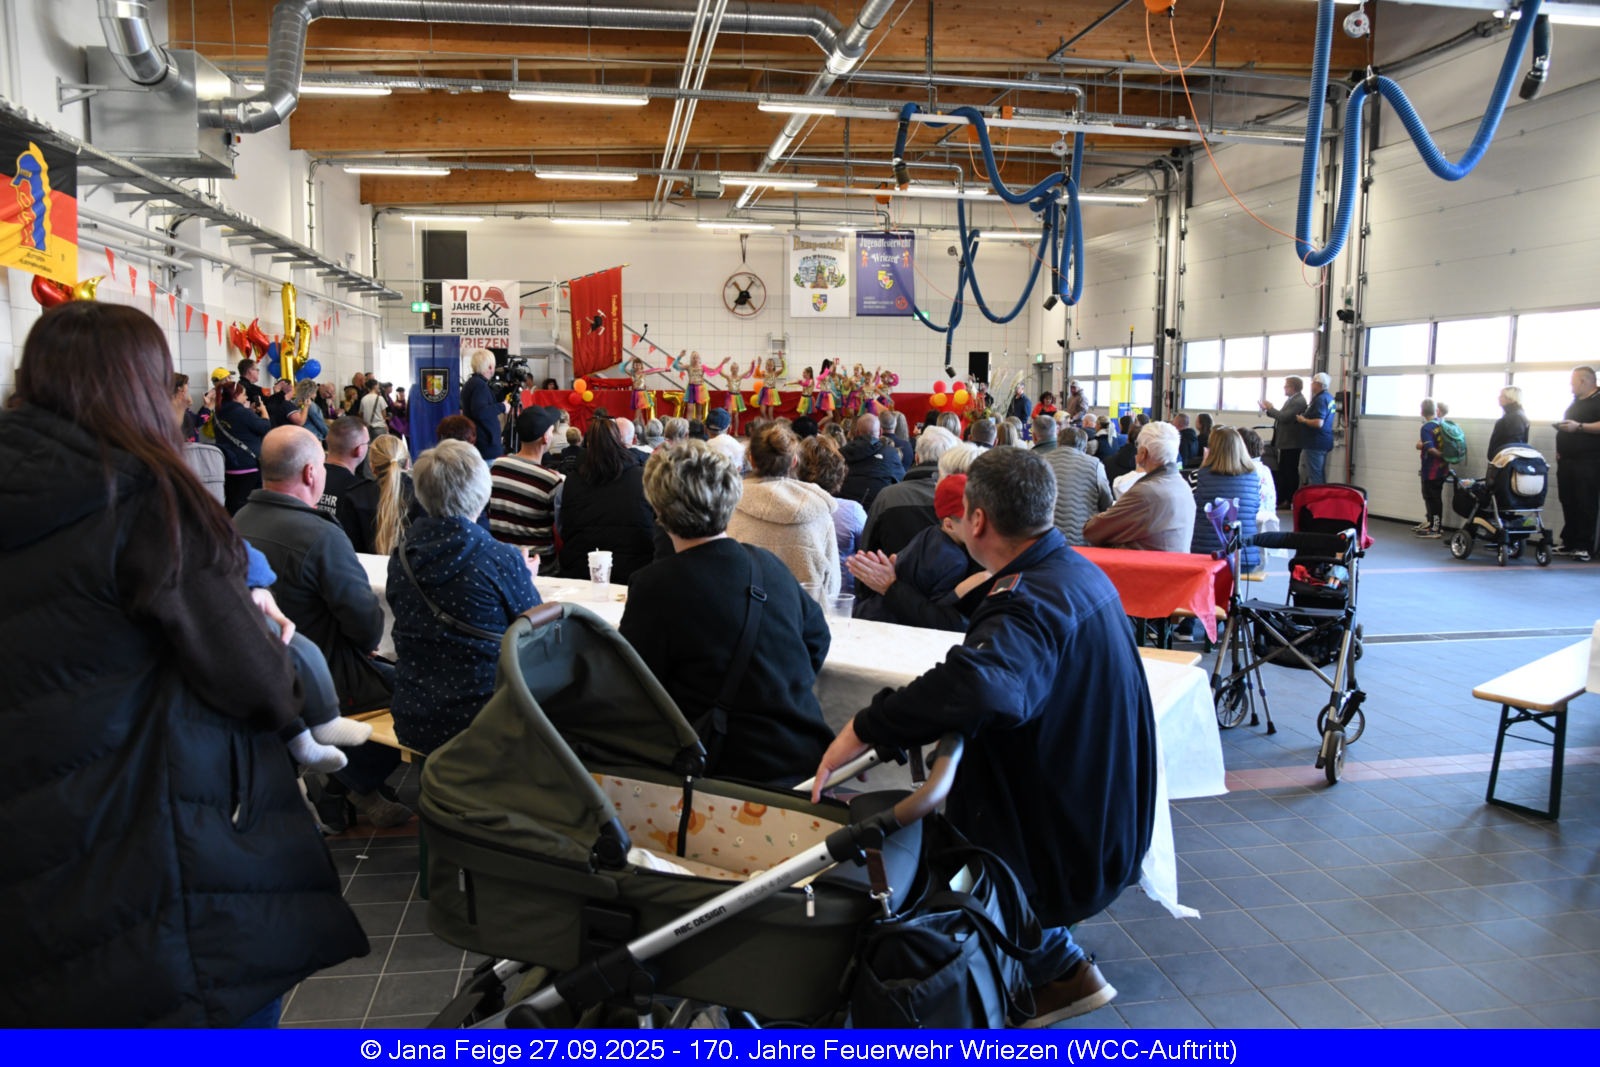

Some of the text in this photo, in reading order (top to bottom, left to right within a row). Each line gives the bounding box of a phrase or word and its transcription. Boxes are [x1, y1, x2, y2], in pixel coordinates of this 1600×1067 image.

[450, 285, 482, 302] 170
[451, 302, 481, 311] JAHRE
[450, 317, 510, 327] FREIWILLIGE
[460, 338, 509, 349] RIEZEN
[694, 905, 727, 928] DESIGN
